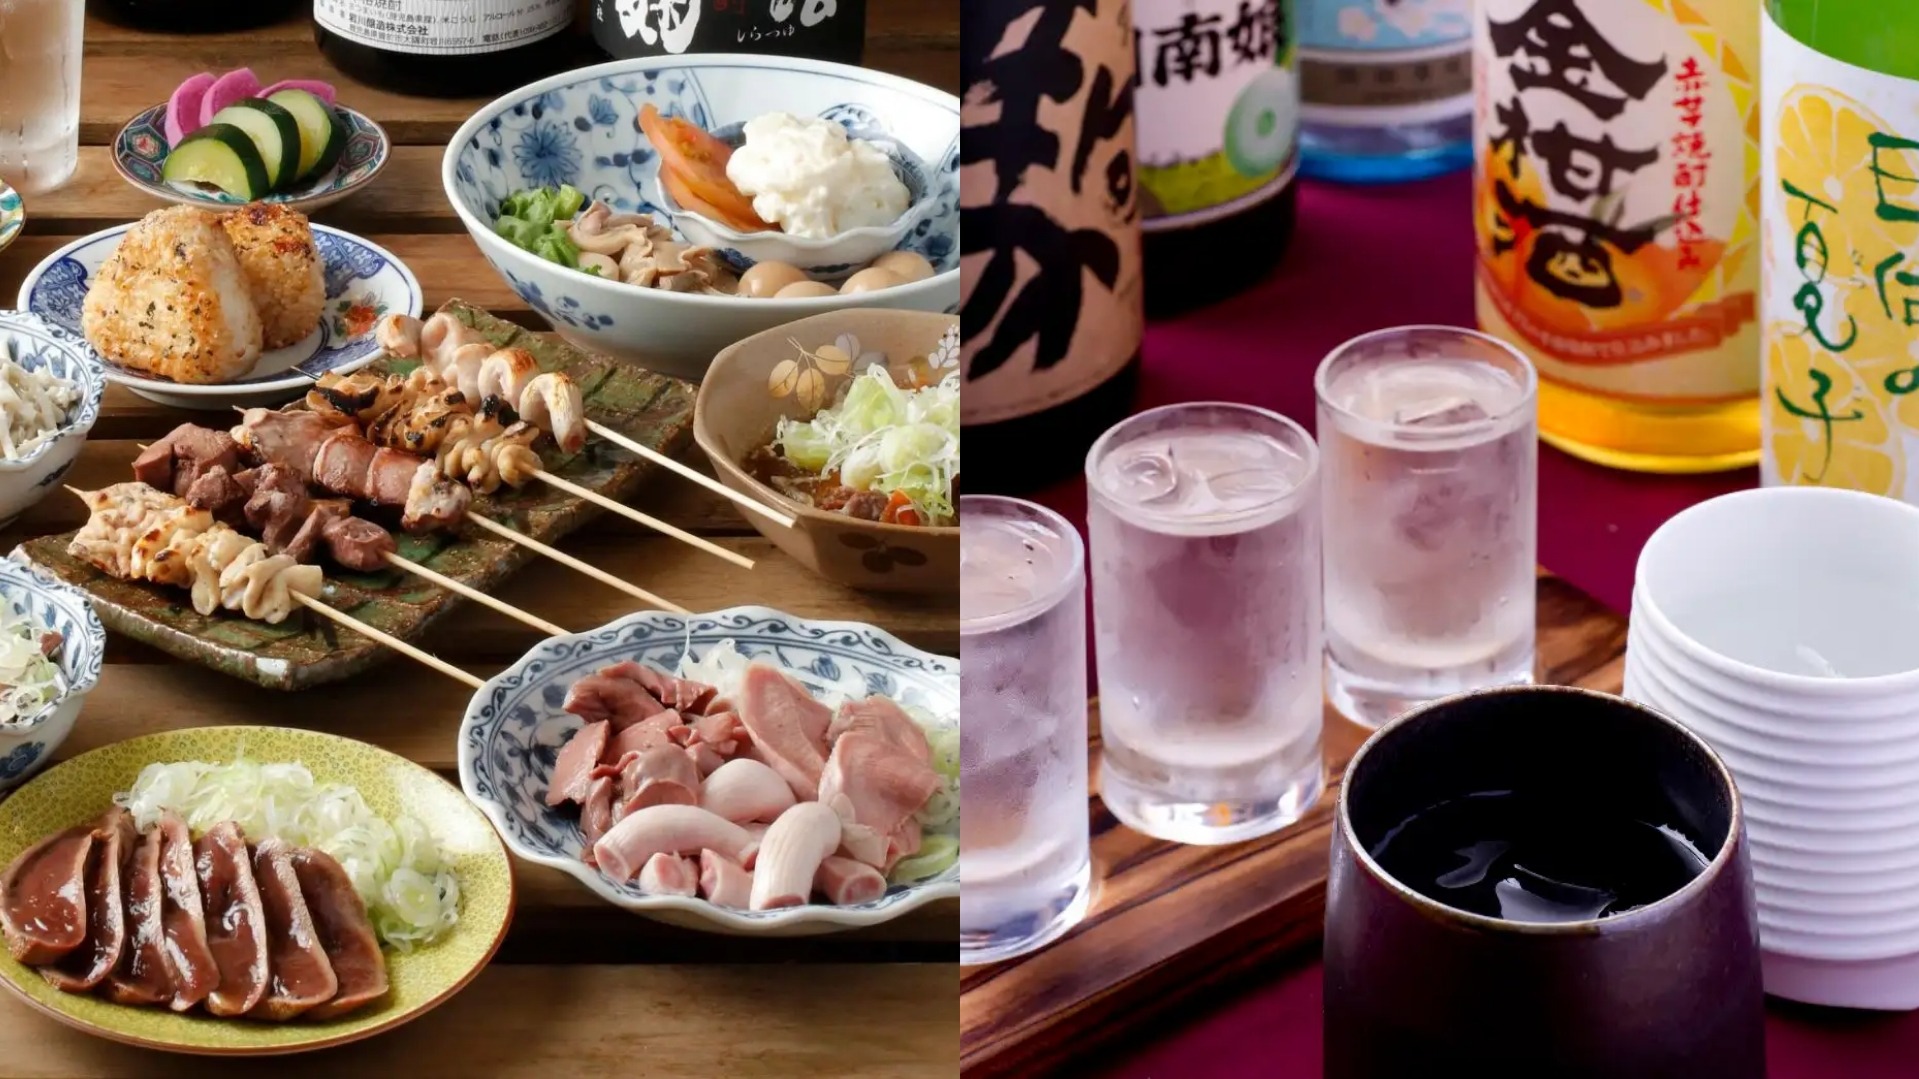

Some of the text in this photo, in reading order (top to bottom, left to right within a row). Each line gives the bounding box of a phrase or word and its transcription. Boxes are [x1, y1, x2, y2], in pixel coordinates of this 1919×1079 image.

[1134, 0, 1285, 88] 南娘
[1488, 0, 1668, 309] 金柑酒
